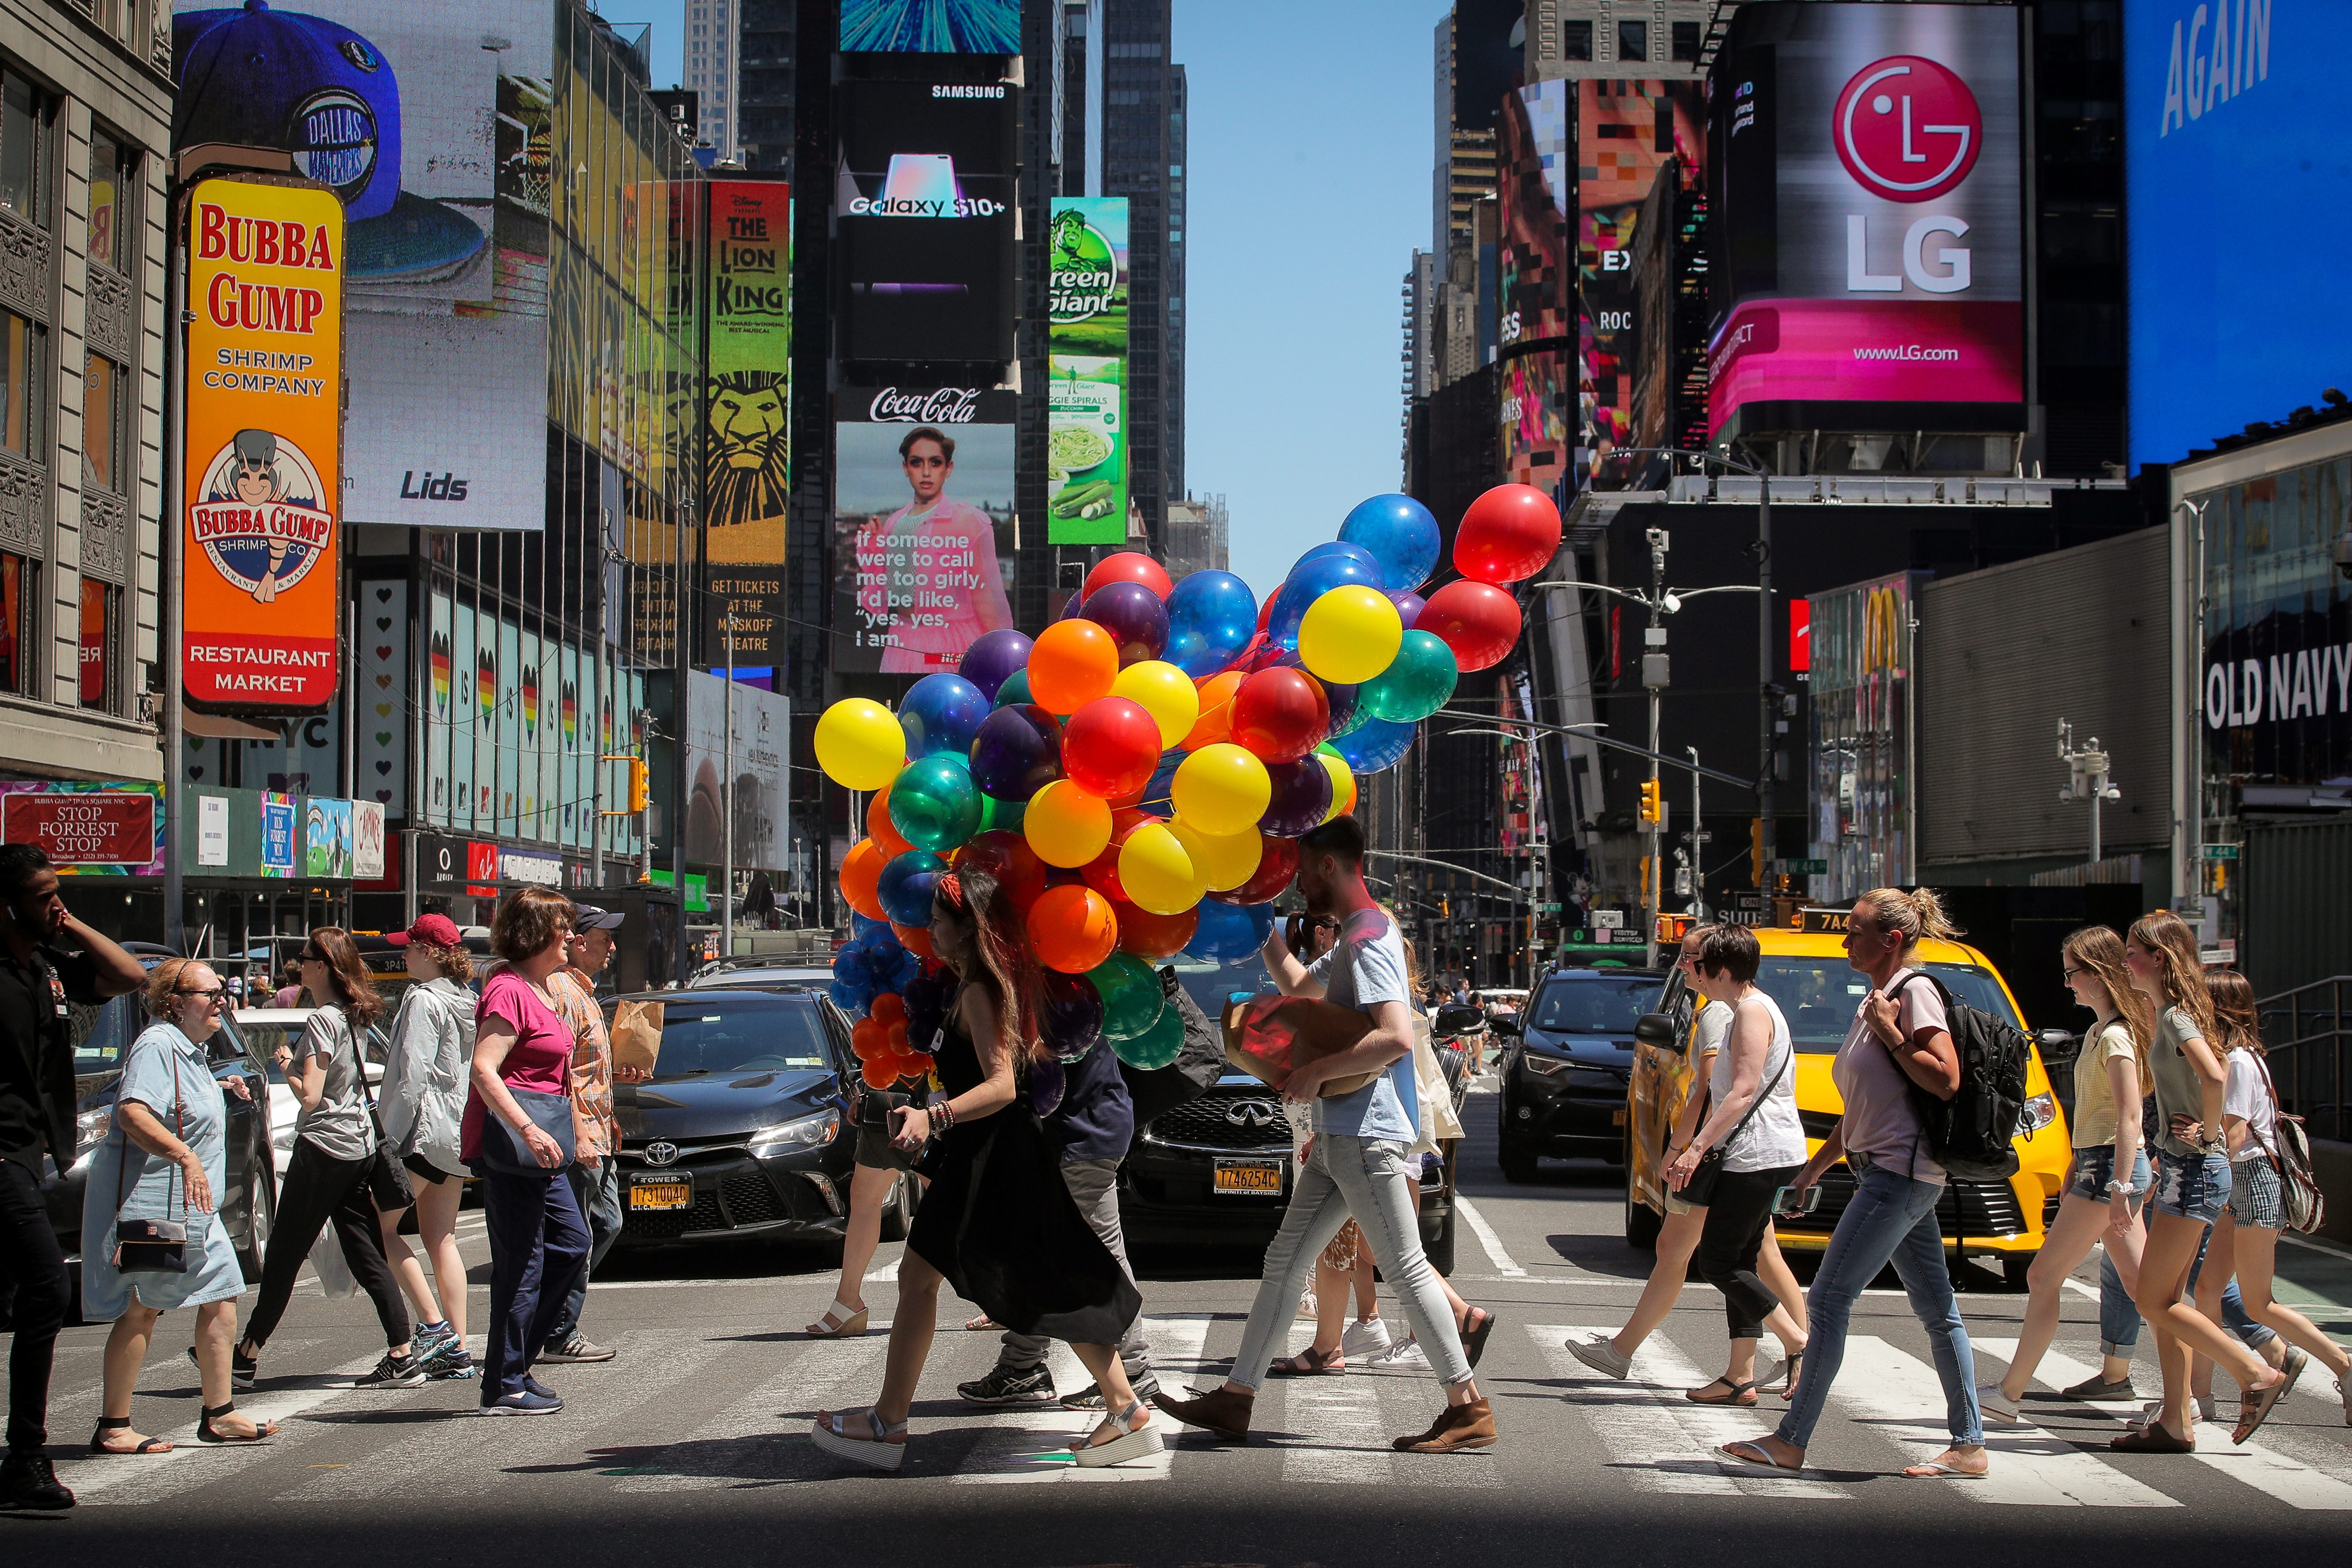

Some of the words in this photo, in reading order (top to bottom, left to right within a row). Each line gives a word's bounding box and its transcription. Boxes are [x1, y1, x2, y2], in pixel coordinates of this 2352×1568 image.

[2160, 0, 2272, 139] AGAIN
[932, 85, 1005, 99] SAMSUNG
[308, 109, 362, 145] DALLAS
[730, 194, 763, 208] Disney
[849, 197, 945, 218] Galaxy
[952, 198, 1005, 217] S10+
[727, 216, 767, 237] THE
[197, 203, 335, 271] BUBBA
[720, 240, 776, 274] LION
[1846, 214, 1972, 294] LG
[1050, 271, 1110, 288] reen
[207, 272, 325, 335] GUMP
[716, 276, 784, 317] KING
[1600, 312, 1632, 330] ROC
[217, 348, 314, 372] SHRIMP
[1853, 344, 1959, 362] www.LG.com
[203, 371, 326, 397] COMPANY
[401, 471, 468, 501] Lids
[196, 508, 266, 537] BUBBA
[271, 507, 328, 543] GUMP
[219, 540, 267, 552] SHRIMP
[288, 543, 306, 556] CO.
[876, 533, 970, 548] someone
[207, 542, 255, 589] RESTAURANT
[286, 551, 317, 584] MARKET
[856, 553, 906, 567] were
[912, 552, 933, 567] to
[938, 551, 975, 567] call
[712, 580, 730, 593] GET
[734, 580, 779, 594] TICKETS
[856, 572, 887, 586] me
[894, 571, 928, 586] too
[935, 570, 985, 591] girly,
[728, 600, 740, 613] AT
[743, 600, 763, 613] THE
[887, 592, 914, 608] be
[919, 591, 960, 610] like,
[718, 618, 773, 632] MNSKOFF
[911, 613, 950, 629] yes,
[856, 630, 861, 647] I
[868, 633, 905, 648] am.
[190, 645, 331, 668] RESTAURANT
[215, 674, 307, 693] MARKET
[2206, 658, 2263, 729] OLD
[2270, 642, 2352, 721] NAVY
[461, 670, 468, 705] IS
[507, 686, 513, 720] IS
[548, 699, 554, 731] IS
[585, 712, 591, 742] IS
[57, 807, 102, 821] STOP
[39, 822, 119, 837] FORREST
[56, 837, 102, 852] STOP
[2216, 847, 2229, 855] 44
[1789, 861, 1798, 873] W
[1802, 861, 1814, 872] 44
[1745, 898, 1761, 907] ONE
[1821, 915, 1849, 930] 7A4
[1221, 1170, 1275, 1188] T746254C
[634, 1186, 686, 1203] T731004C
